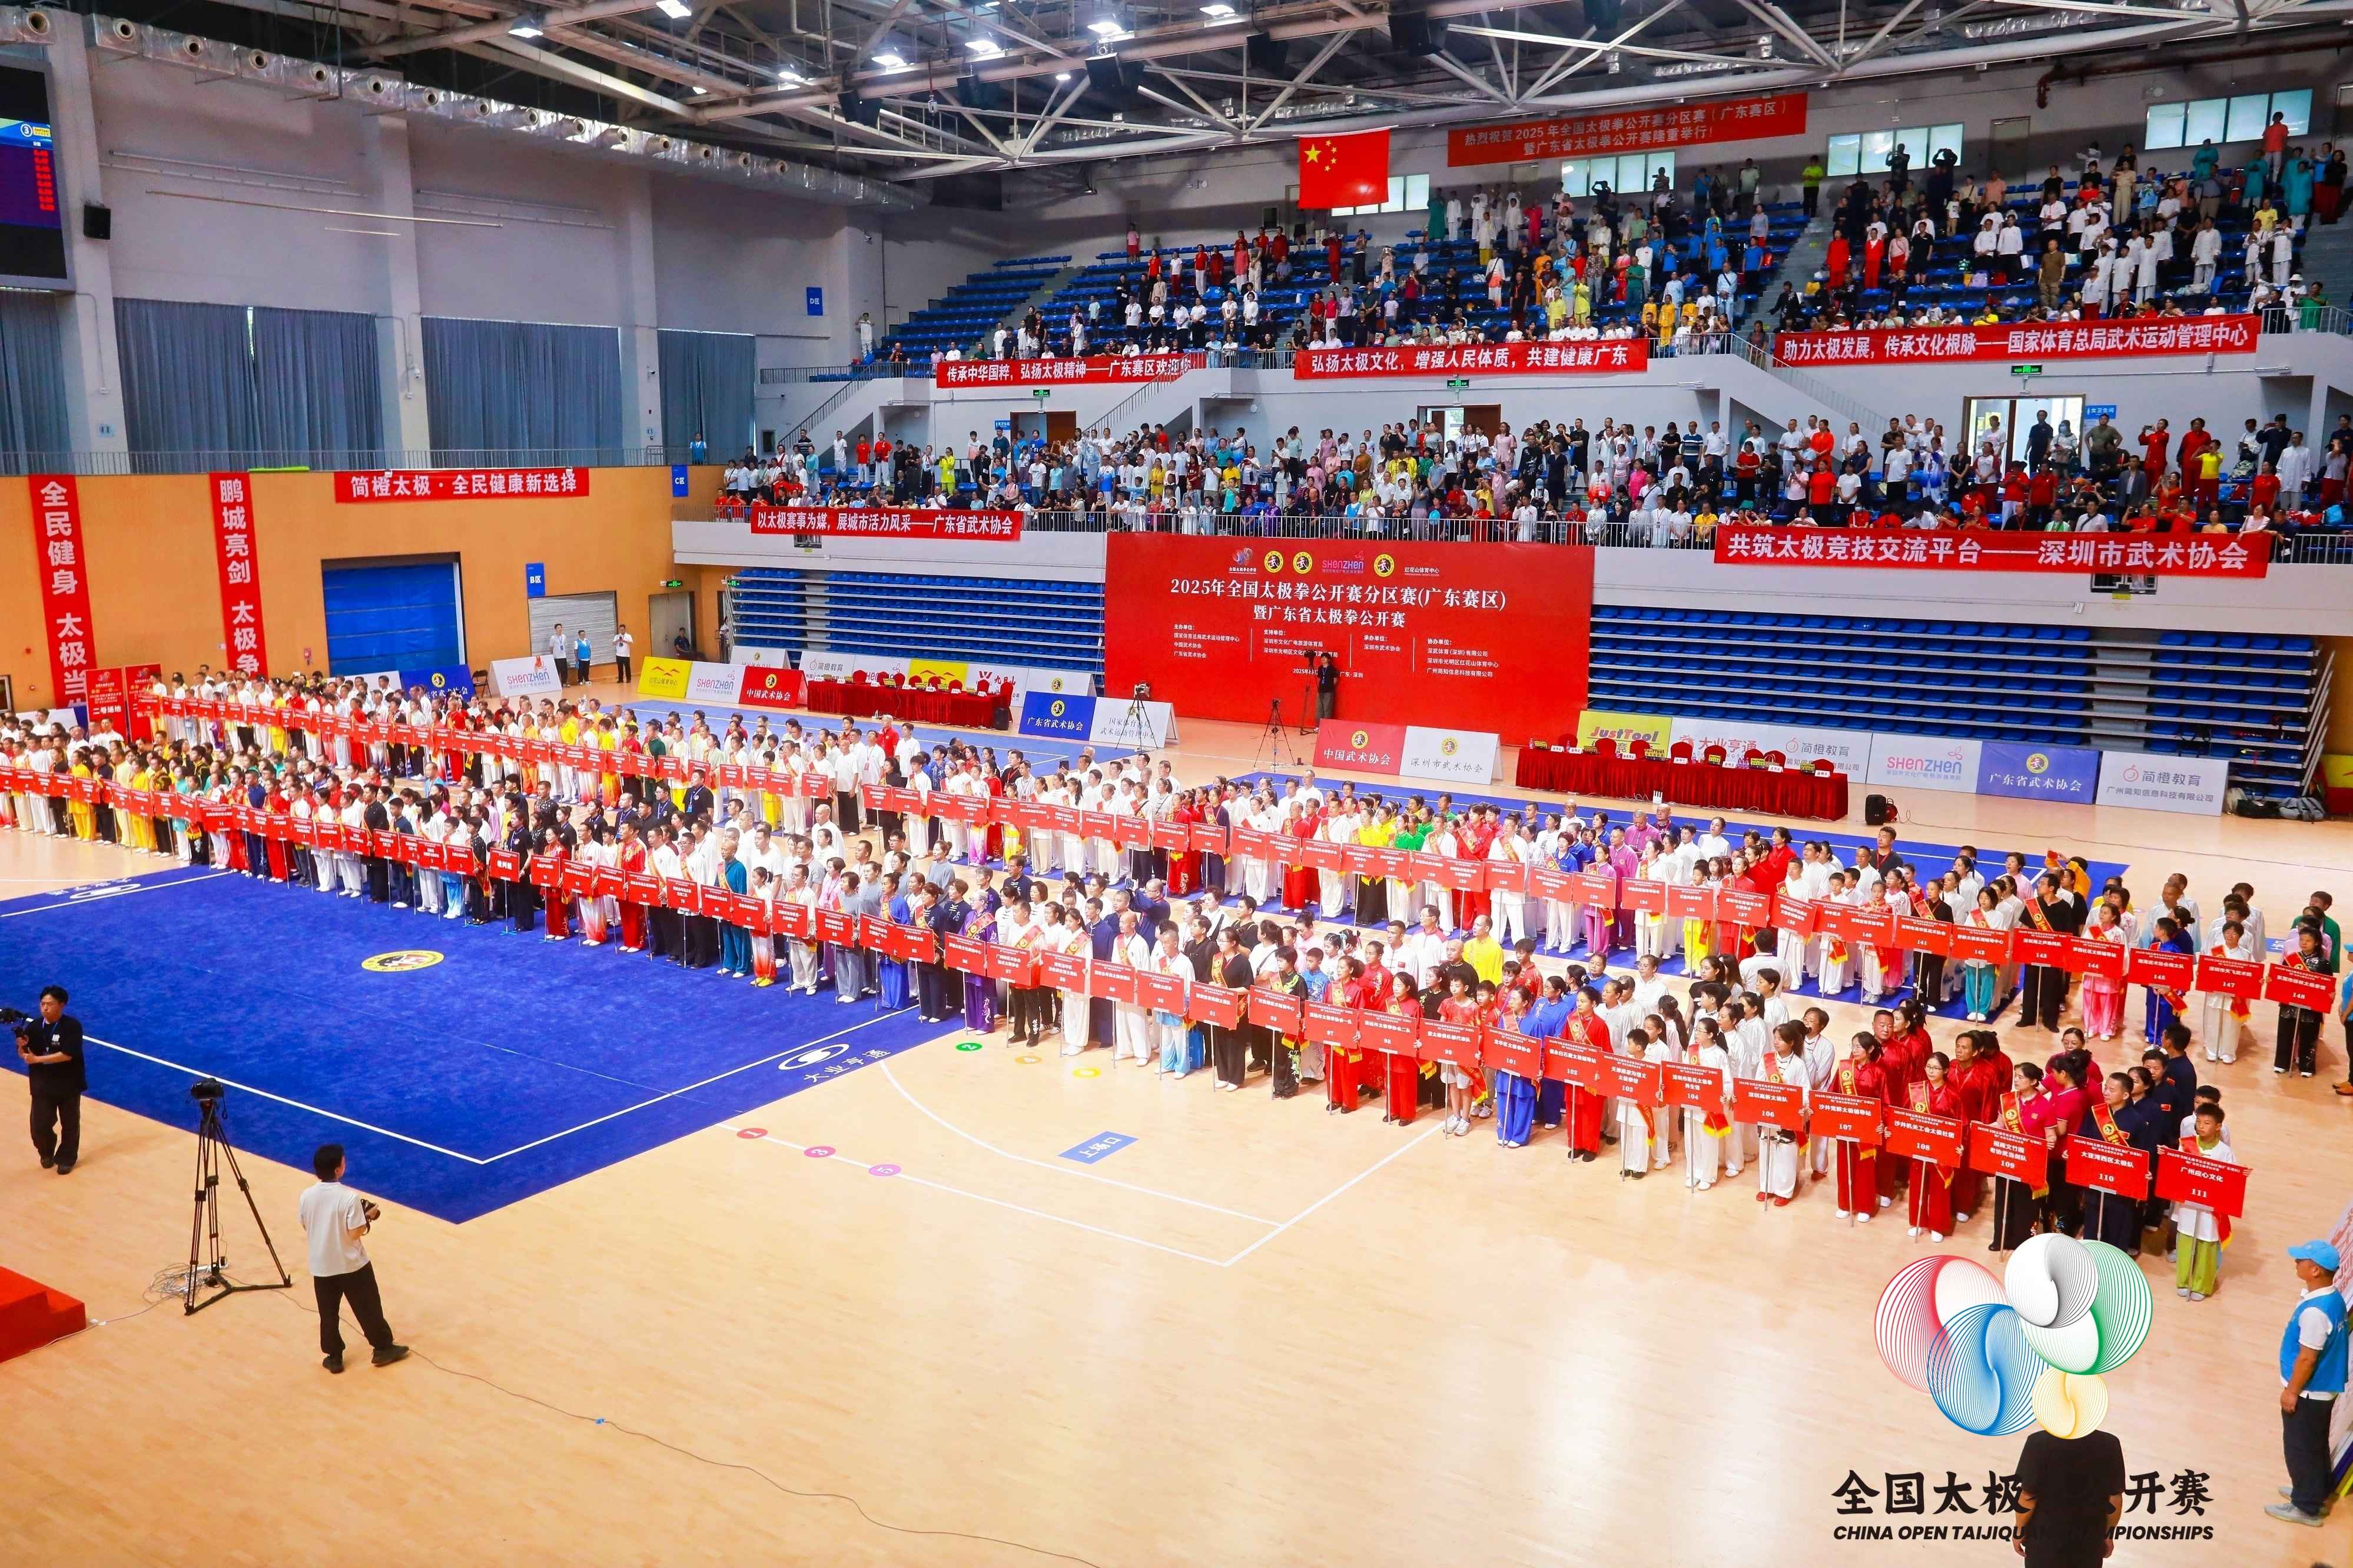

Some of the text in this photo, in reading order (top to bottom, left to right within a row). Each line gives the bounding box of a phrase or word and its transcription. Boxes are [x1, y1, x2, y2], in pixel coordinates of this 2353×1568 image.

[1311, 345, 1628, 373] 弘扬太极文化，增强人民体质，共建健康广东
[675, 477, 685, 486] C区
[41, 481, 77, 595] 全民健身
[220, 479, 251, 584] 鹏城亮剑
[530, 575, 542, 584] B区
[1253, 604, 1406, 627] 暨广东省太极拳公开赛
[1174, 633, 1239, 642] 国家体育总局武术运动管理中心
[1263, 639, 1323, 647] 深圳市文化广电旅游体育局
[1363, 644, 1401, 652] 深圳市武术协会
[1427, 657, 1499, 668] 深圳市光明区红花山体育中心
[746, 688, 791, 701] 中国武术协会
[1027, 716, 1084, 731] 广东省武术协会
[1591, 726, 1659, 742] JustTool
[1698, 737, 1757, 753] 大业亨通
[1801, 742, 1850, 757] 简橙教育
[1324, 748, 1391, 766] 中国武术协会
[1411, 757, 1484, 773] 深圳市武术协会
[1989, 773, 2083, 792] 广东省武术协会
[2142, 770, 2202, 787] 简橙教育
[2106, 786, 2214, 803] 广州简知信息科技有限公司
[802, 1048, 891, 1084] 大业亨通
[1077, 1135, 1123, 1160] 上场口
[1916, 1142, 1930, 1151] 108
[2001, 1160, 2015, 1169] 109
[2081, 1152, 2134, 1168] 大亚湾西区太极队
[2099, 1173, 2114, 1182] 110
[2181, 1167, 2223, 1182] 广州应心文化
[2191, 1188, 2208, 1198] 111
